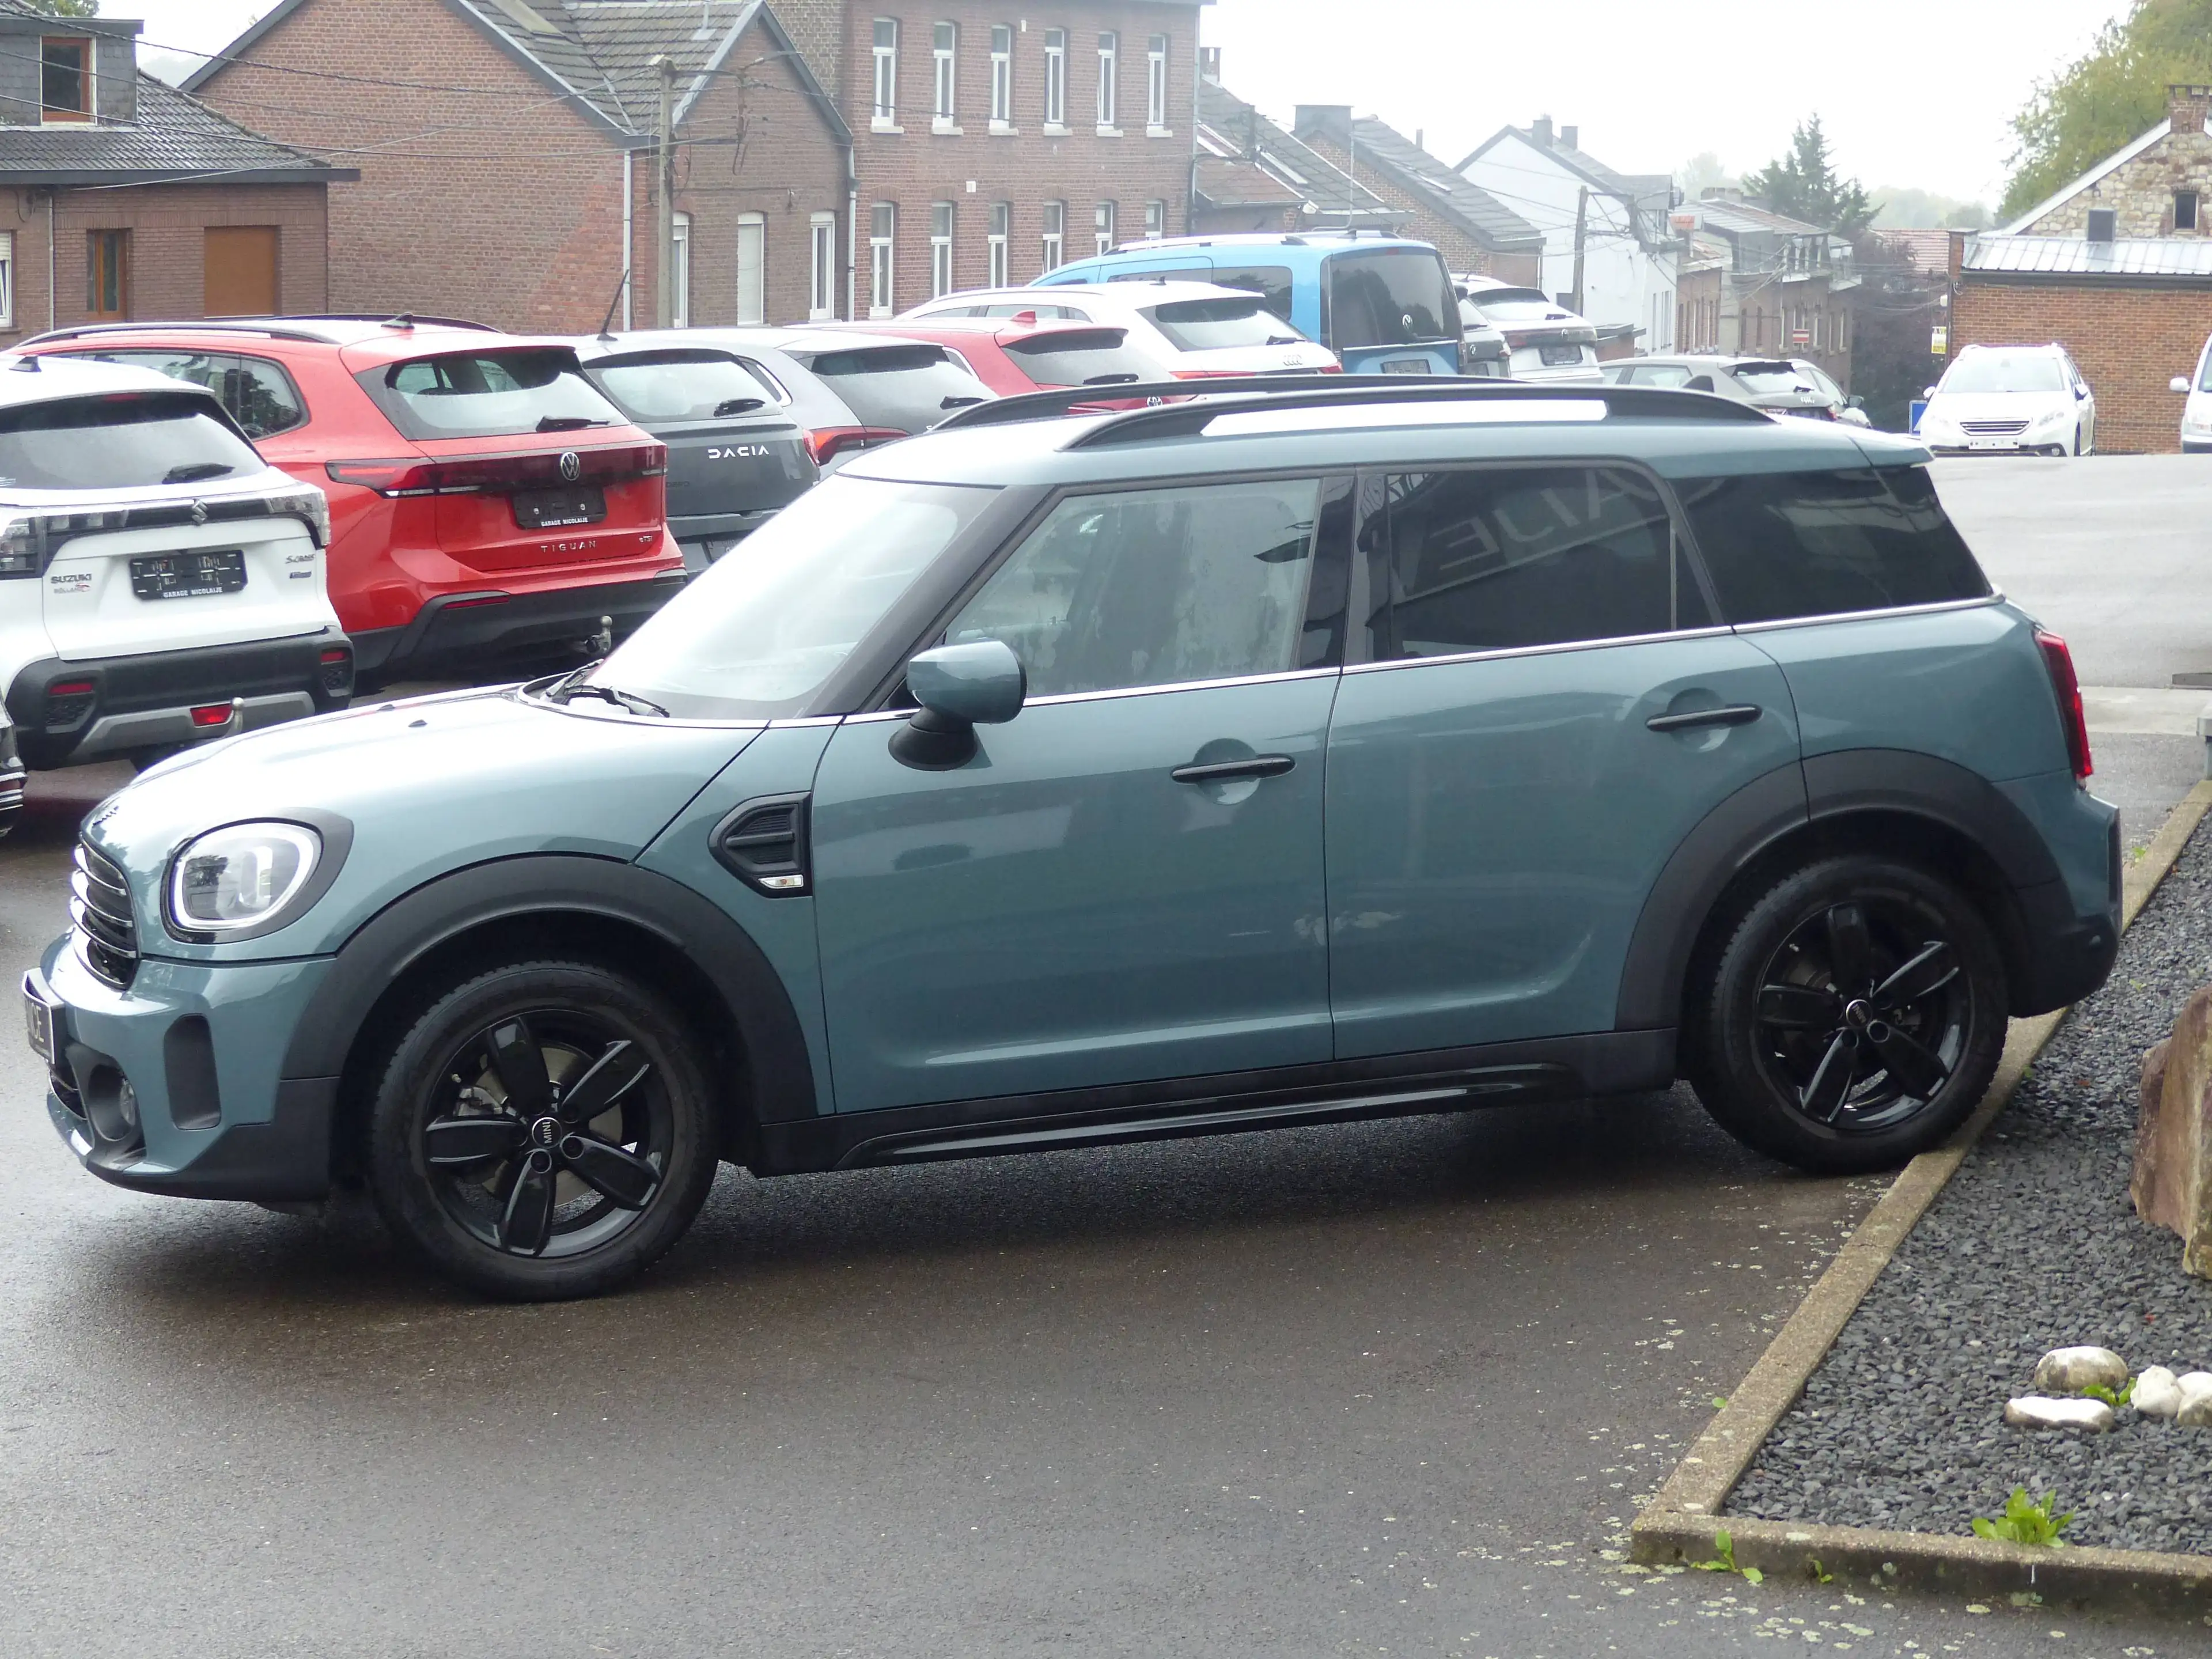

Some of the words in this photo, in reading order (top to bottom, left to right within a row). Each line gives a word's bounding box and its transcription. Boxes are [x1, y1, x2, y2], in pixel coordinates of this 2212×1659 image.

[708, 445, 770, 459] DACIA
[541, 518, 562, 527] GARAGE
[541, 540, 597, 553] TIGUAN
[51, 573, 92, 584] SUZUKI
[163, 590, 189, 598] GARAGE
[190, 586, 223, 596] NICOLAIJE
[542, 1121, 552, 1144] MINI
